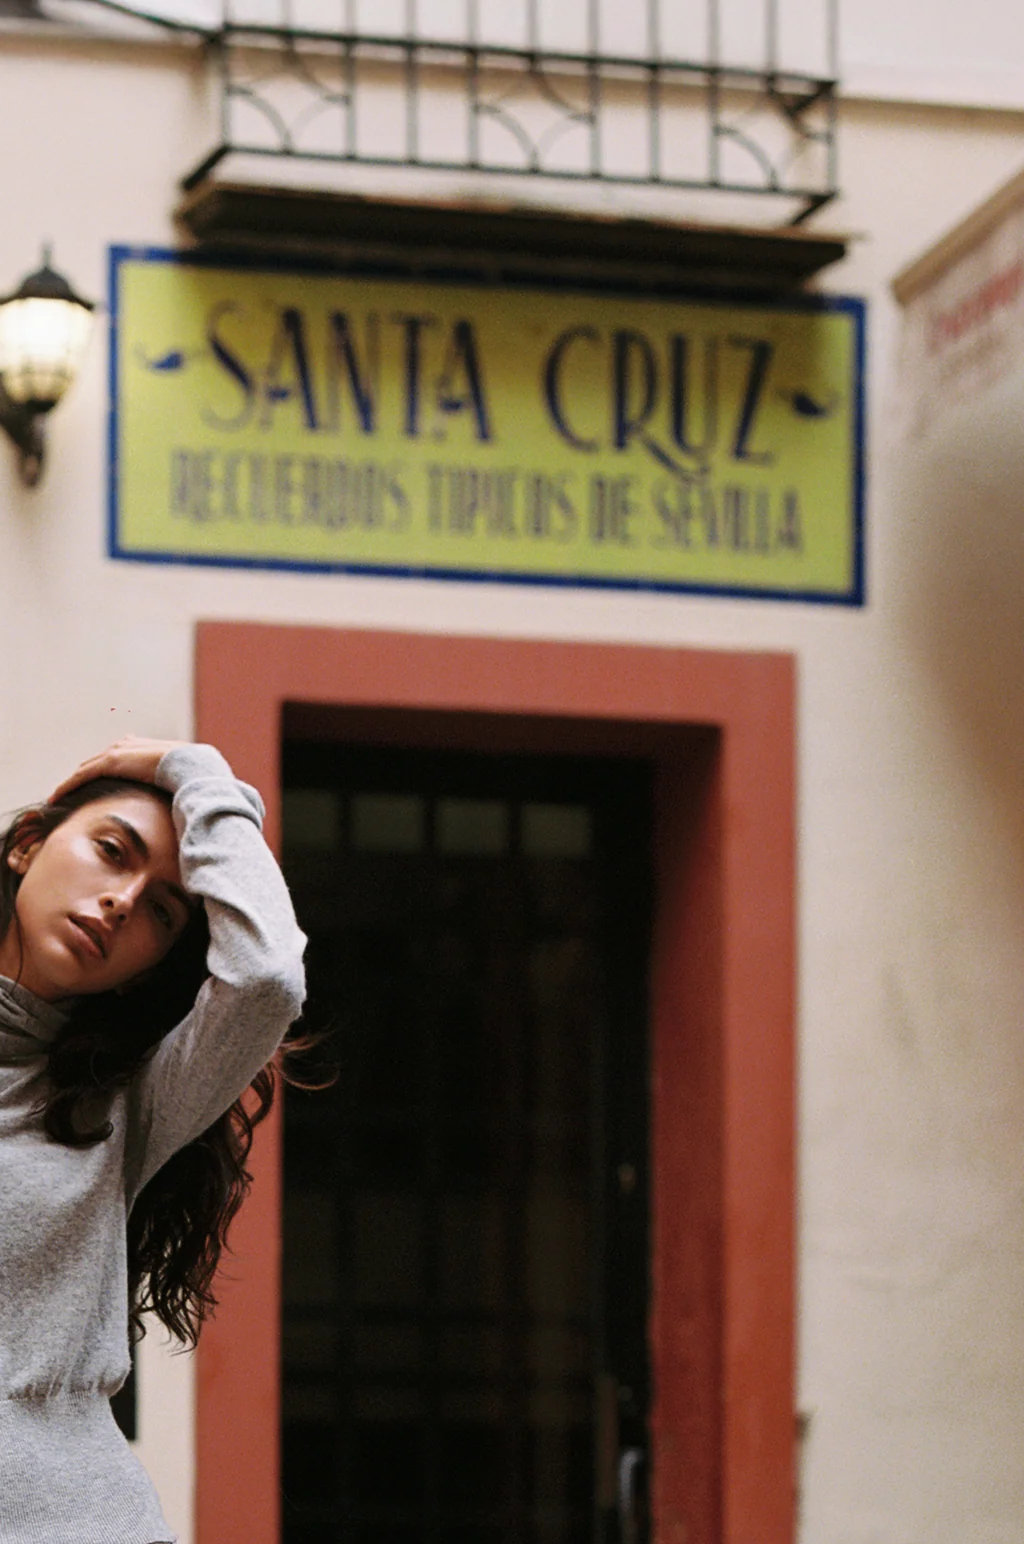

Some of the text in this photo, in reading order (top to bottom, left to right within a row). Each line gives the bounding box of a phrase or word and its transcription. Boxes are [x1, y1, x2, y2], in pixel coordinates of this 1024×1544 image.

[200, 301, 777, 486] SANTA CRUZ
[171, 449, 803, 556] RECUERDOS TIPICOS DE SEVILLA
